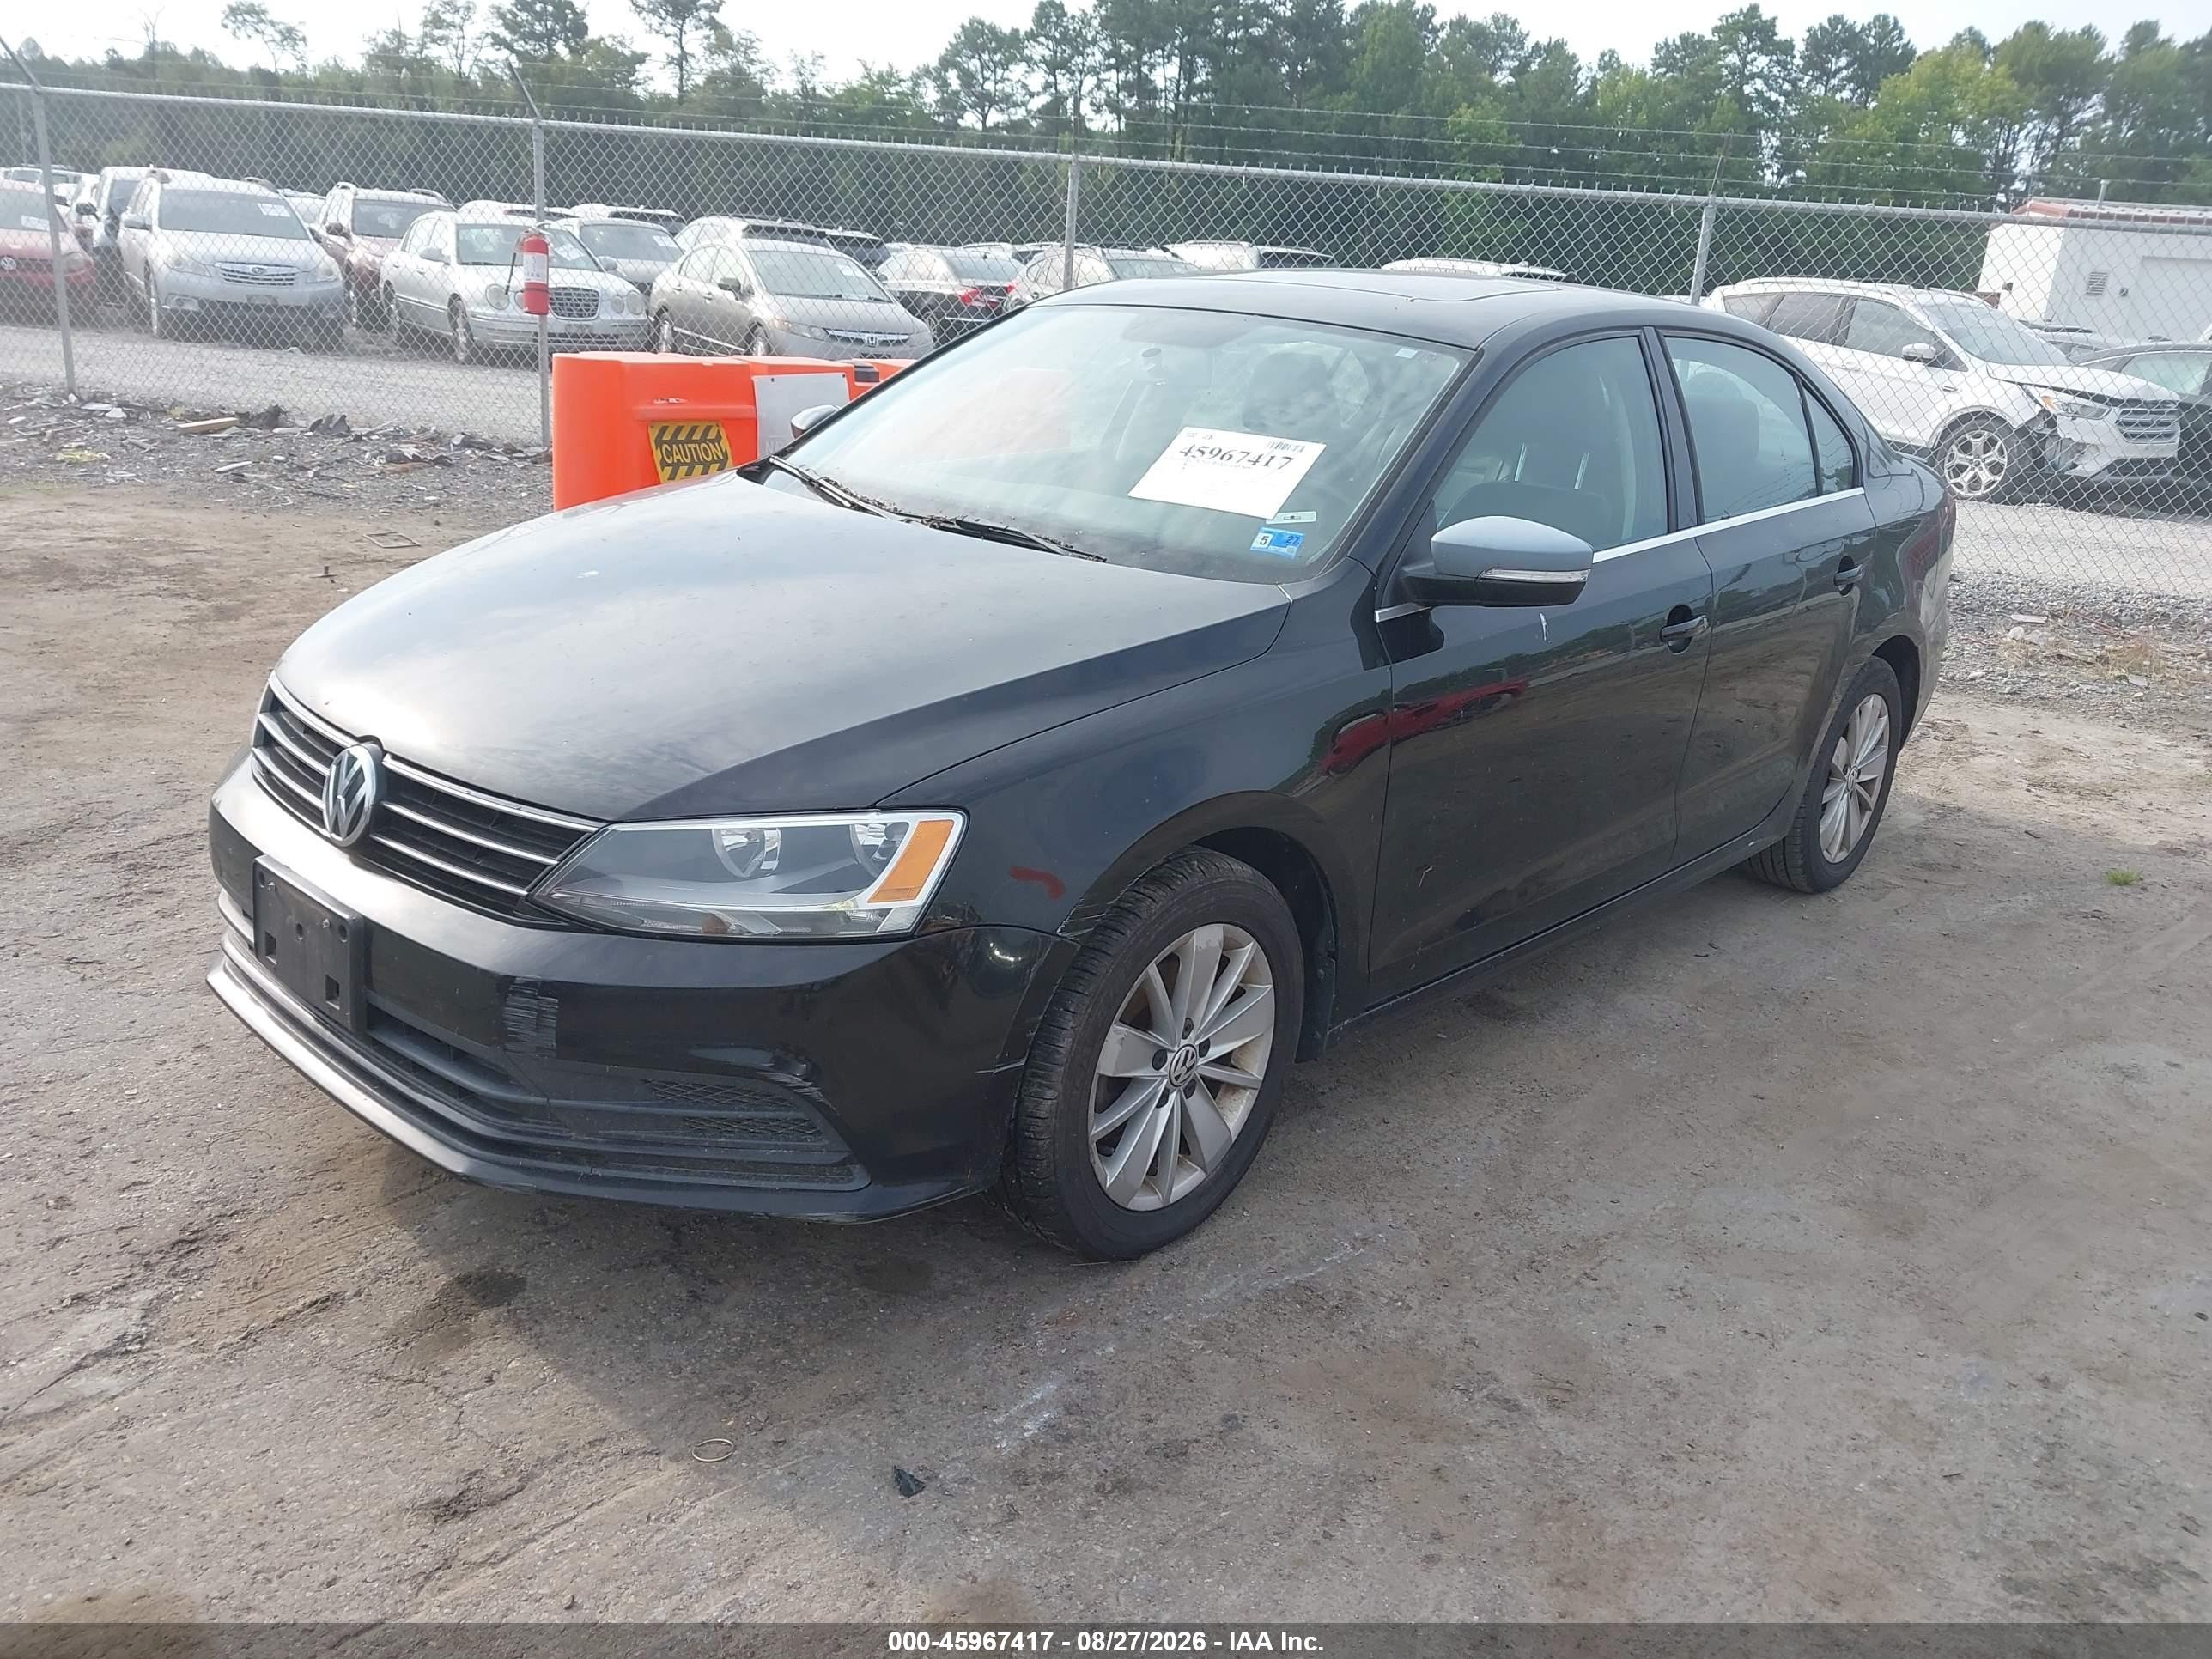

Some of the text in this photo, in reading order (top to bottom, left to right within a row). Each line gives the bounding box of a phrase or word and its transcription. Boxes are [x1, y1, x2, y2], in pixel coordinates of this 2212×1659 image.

[661, 441, 724, 464] CAUTION
[1179, 443, 1294, 470] 45967417
[1259, 535, 1301, 545] 5 27
